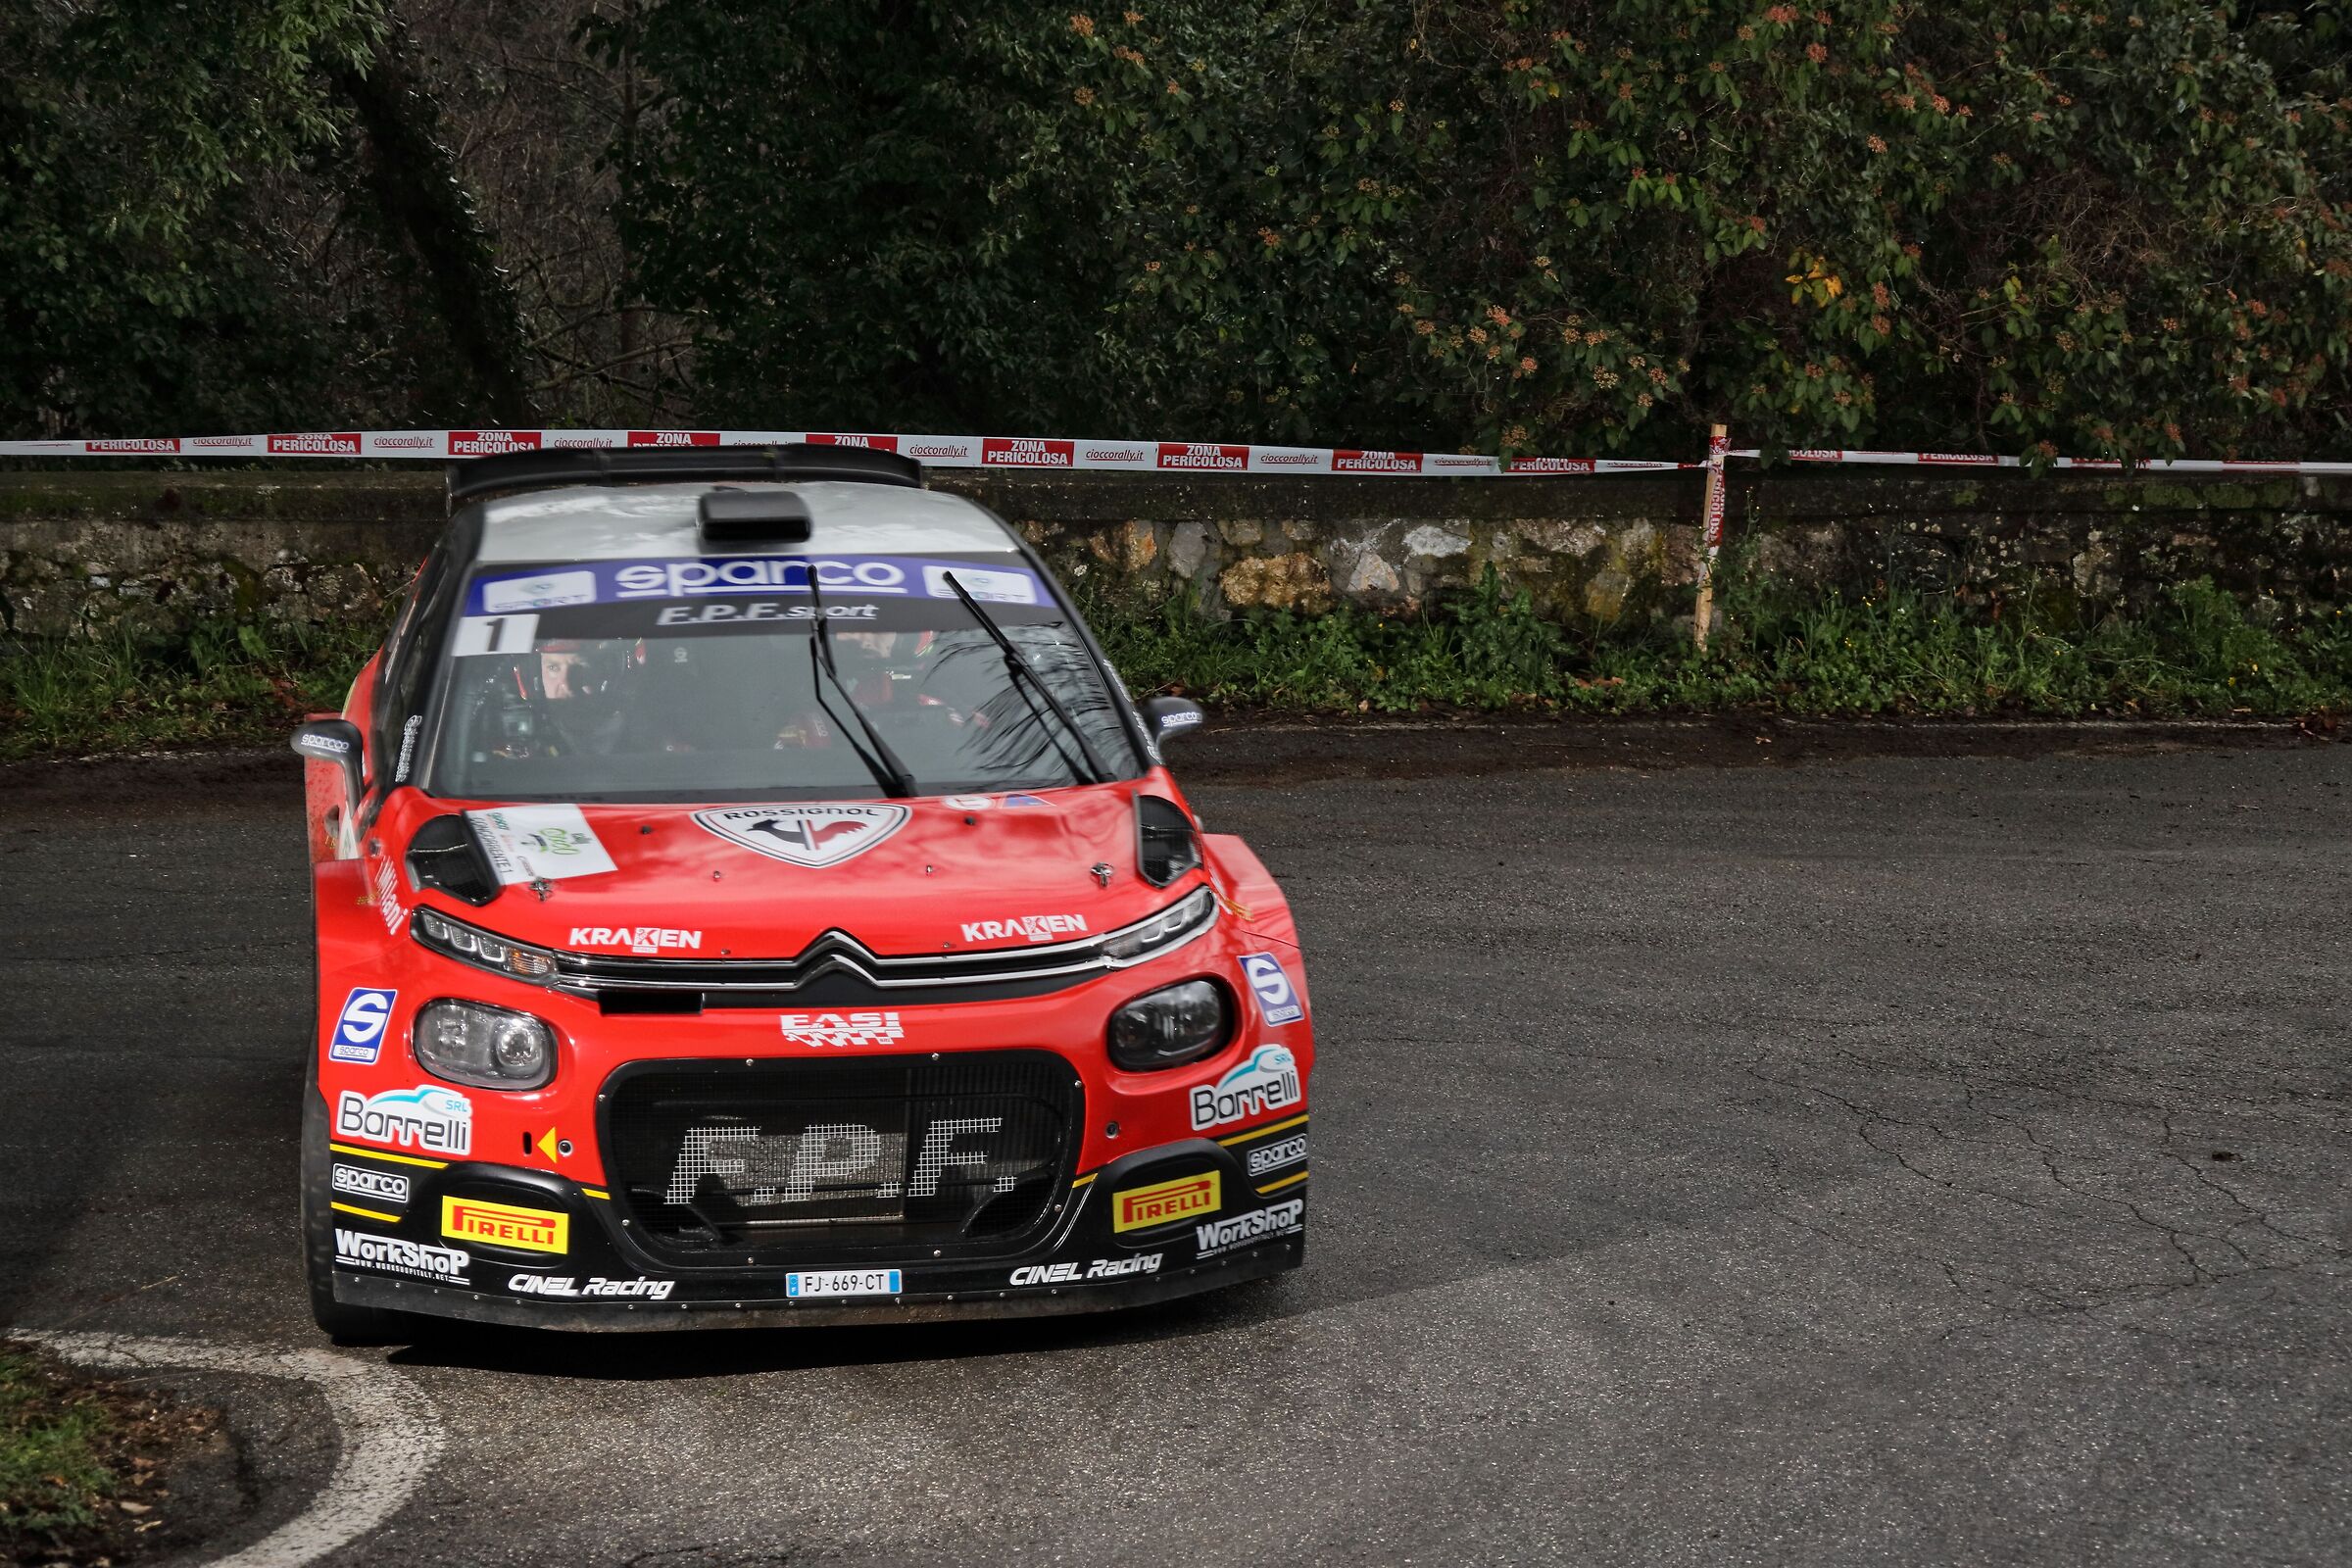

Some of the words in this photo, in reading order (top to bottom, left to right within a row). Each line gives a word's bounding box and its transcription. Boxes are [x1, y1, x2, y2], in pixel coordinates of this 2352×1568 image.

[193, 437, 252, 447] cioccorally.it
[373, 436, 433, 449] cioccorally.it
[477, 432, 513, 441] ZONA
[656, 432, 692, 444] ZONA
[834, 435, 869, 447] ZONA
[91, 440, 175, 451] PERICOLOSA
[273, 440, 356, 452] PERICOLOSA
[454, 441, 535, 454] PERICOLOSA
[909, 444, 968, 458] cioccorally.it
[1011, 440, 1046, 452] ZONA
[1186, 445, 1221, 457] ZONA
[987, 451, 1068, 465] PERICOLOSA
[1085, 449, 1144, 462] cioccorally.it
[1162, 455, 1243, 467] PERICOLOSA
[1259, 453, 1318, 465] cioccorally.it
[1360, 451, 1396, 461] ZONA
[1337, 459, 1417, 470] PERICOLOSA
[615, 560, 906, 597] sparco
[485, 616, 506, 653] 1
[1161, 711, 1201, 726] sparco
[301, 733, 350, 753] sparco
[469, 816, 512, 869] CONCORRENTE
[960, 913, 1089, 942] KRAKEN
[568, 927, 703, 950] KRAKEN
[339, 1046, 369, 1057] sparco
[446, 1099, 467, 1112] SRL
[663, 1117, 1018, 1205] F.P.F.
[1250, 1138, 1306, 1171] sparco
[334, 1167, 408, 1198] sparco
[1122, 1179, 1213, 1224] PIRELLI
[452, 1204, 557, 1245] PIRELLI
[1008, 1262, 1083, 1286] CINEL
[1087, 1252, 1164, 1279] Racing
[508, 1274, 579, 1298] CINEL
[582, 1276, 676, 1300] Racing
[805, 1274, 885, 1293] FJ-669-CT
